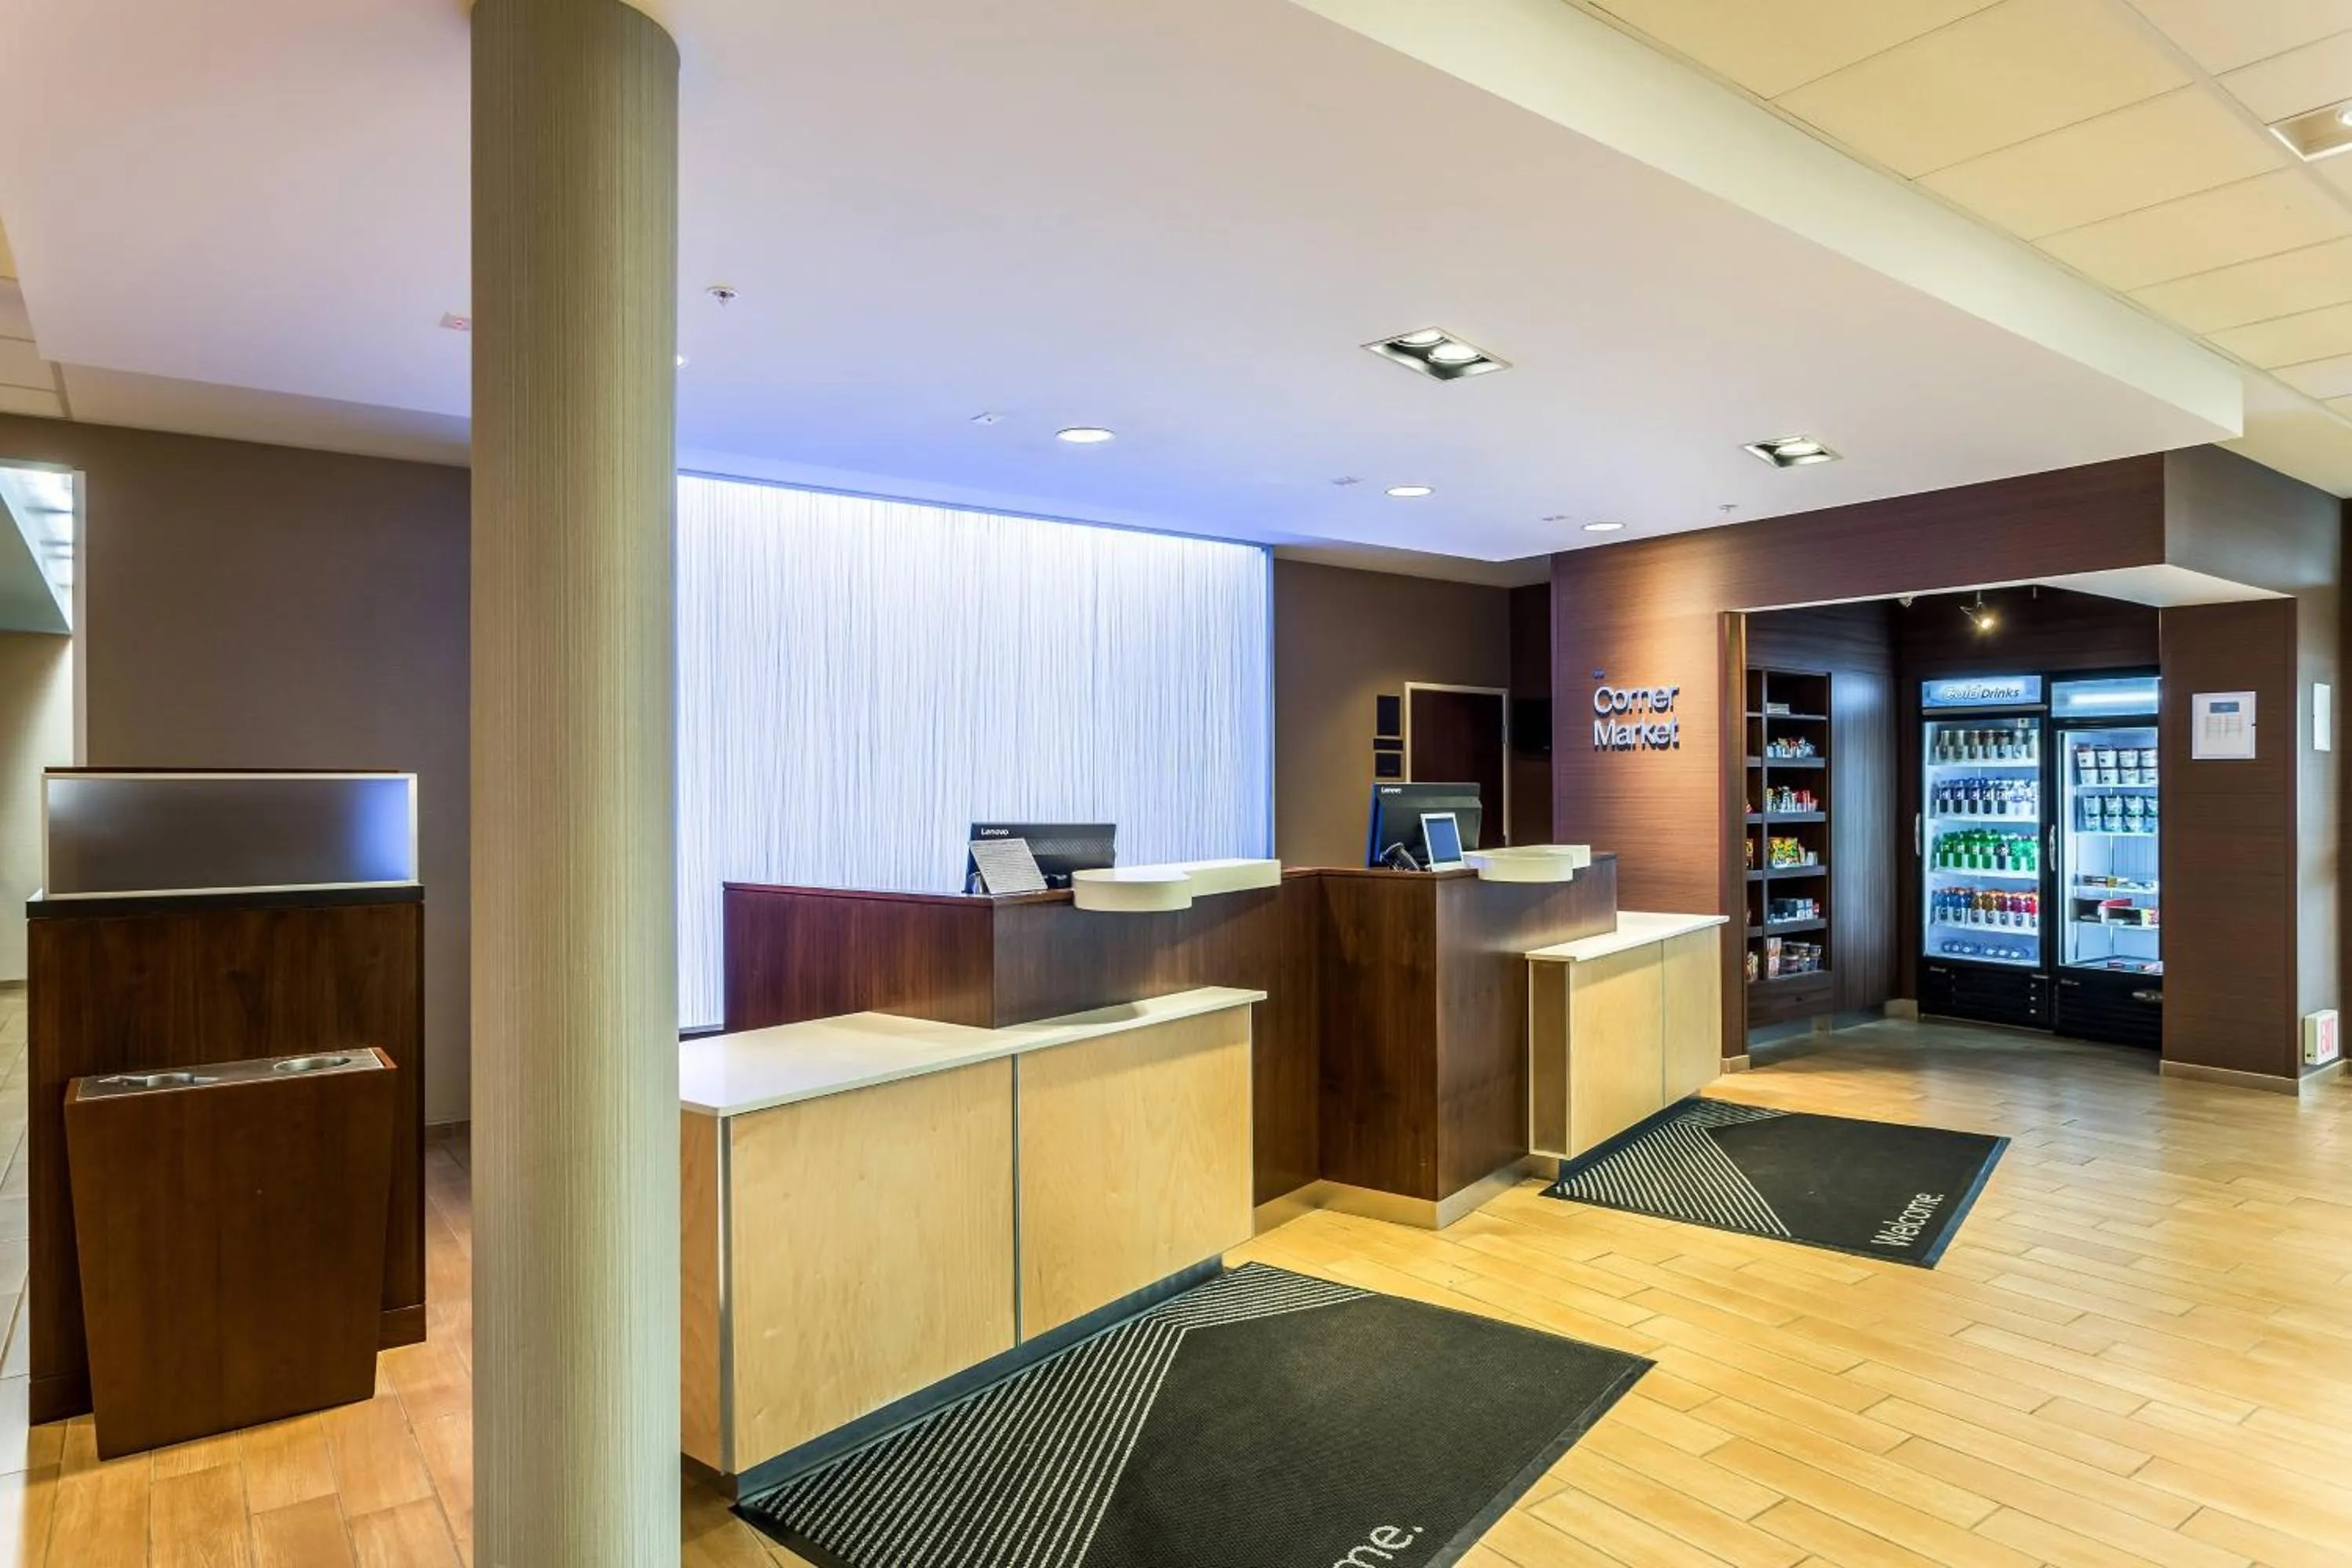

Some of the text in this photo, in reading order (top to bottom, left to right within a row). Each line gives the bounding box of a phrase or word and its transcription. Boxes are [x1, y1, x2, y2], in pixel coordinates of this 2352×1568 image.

[1593, 686, 1679, 714] Corner
[1981, 686, 2020, 699] Drinks
[1593, 717, 1679, 746] Market
[980, 827, 1009, 837] Lenovo
